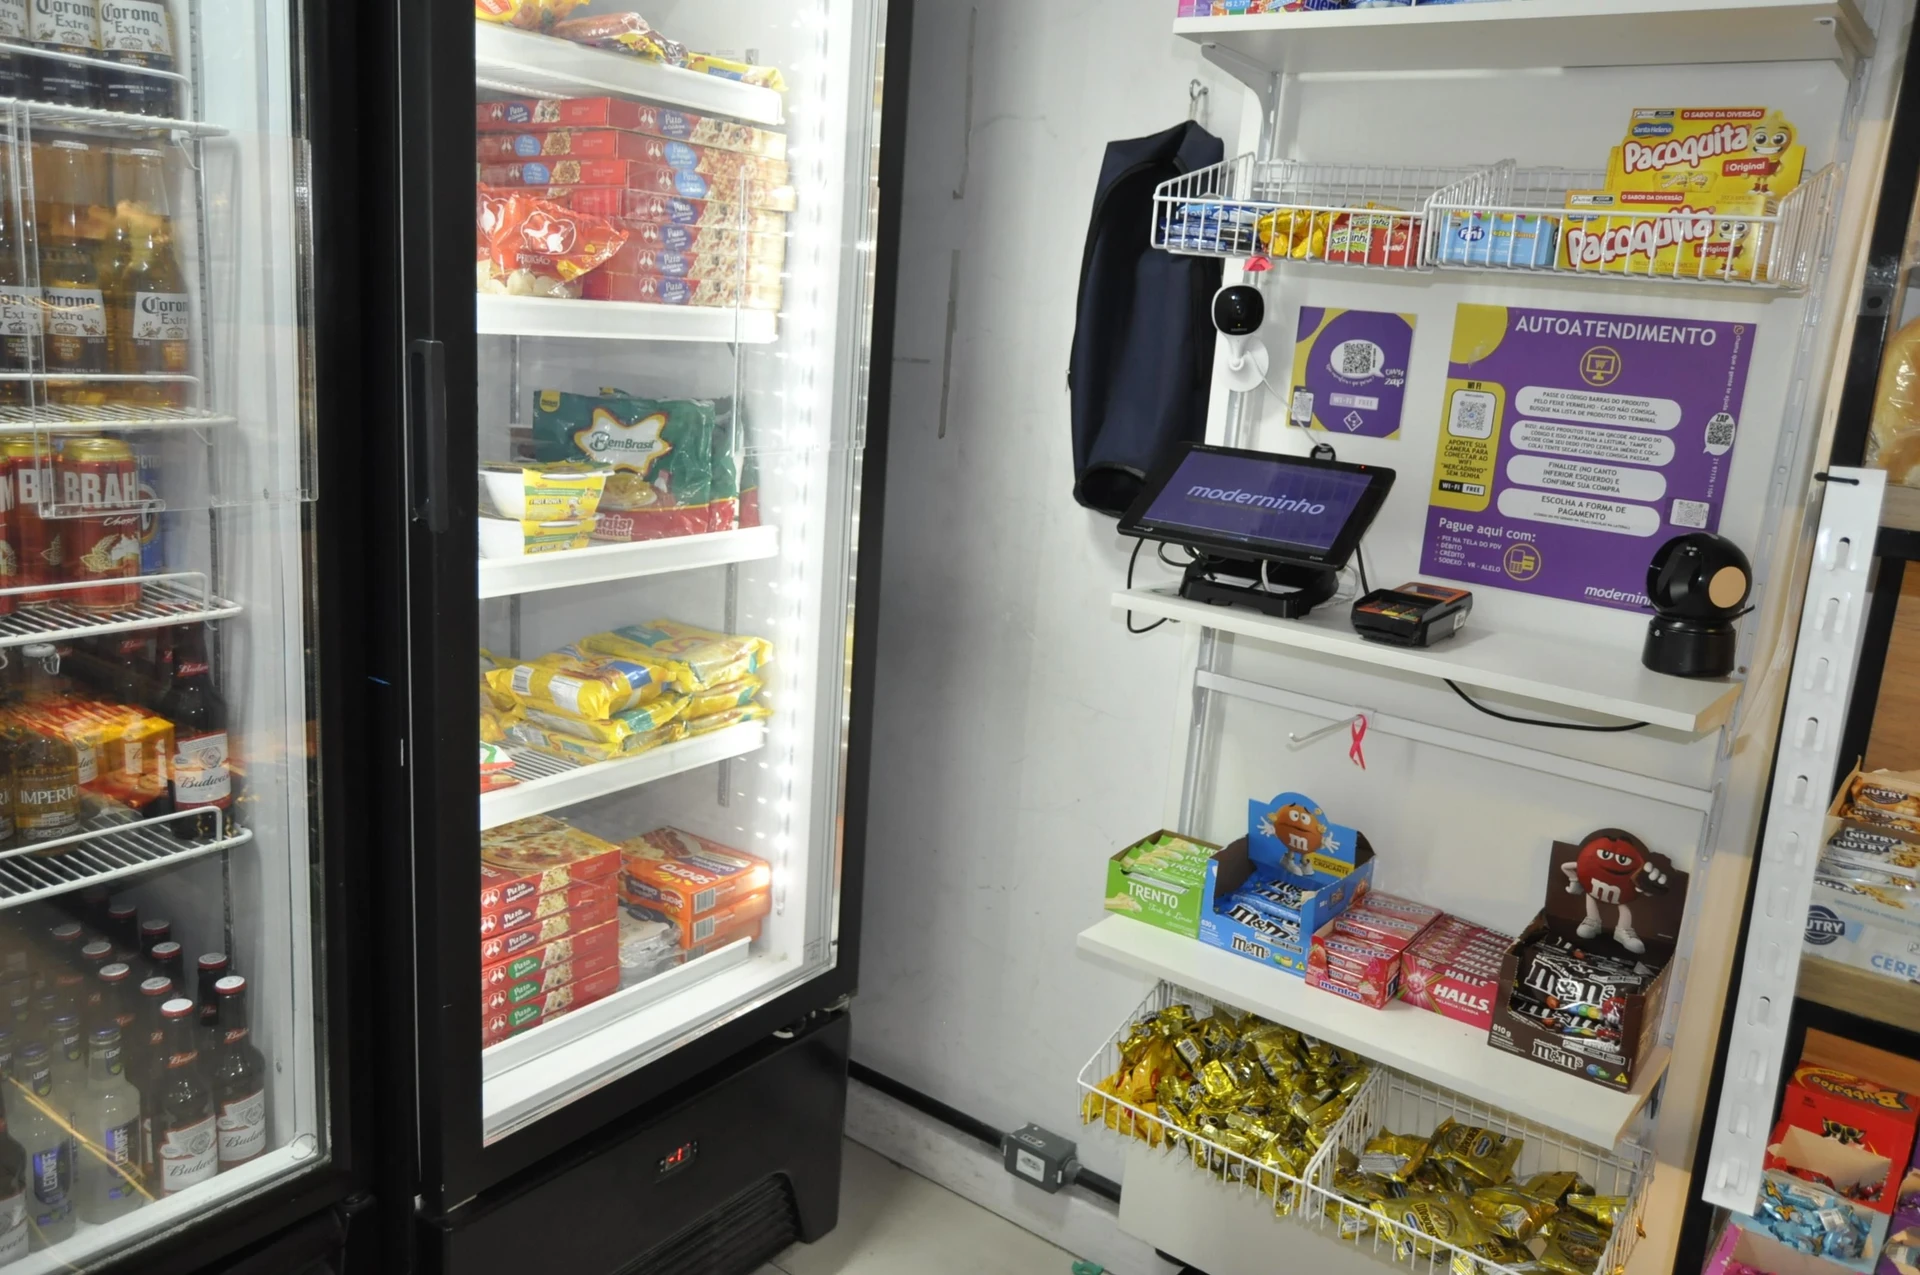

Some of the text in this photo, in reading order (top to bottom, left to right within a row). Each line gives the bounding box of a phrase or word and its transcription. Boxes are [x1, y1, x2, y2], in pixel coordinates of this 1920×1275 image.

[101, 2, 162, 26] Corona
[56, 14, 89, 31] Extra
[115, 22, 150, 36] Extra
[1715, 110, 1725, 118] DA
[1727, 109, 1762, 117] DIVERSÃO
[1624, 123, 1749, 174] Paçoquita
[1729, 162, 1765, 172] Original
[1514, 314, 1717, 347] AUTOATENDIMENTO
[1467, 381, 1482, 390] WI FI
[1542, 390, 1559, 398] PASSE
[1565, 393, 1588, 401] CÓDIGO
[1588, 395, 1610, 403] BARRAS
[1620, 398, 1650, 407] PRODUTO
[1528, 404, 1551, 412] BUSQUE
[1586, 410, 1616, 419] PRODUTOS
[1628, 415, 1656, 424] TERMINAL
[1533, 397, 1548, 405] PELO
[1548, 399, 1564, 407] FEIXE
[1565, 400, 1595, 410] VERMELHO
[1599, 404, 1616, 412] CASO
[1630, 407, 1658, 416] CONSIGA,
[1715, 413, 1729, 422] ZAP
[1444, 444, 1489, 455] CAMERA PARA
[1448, 438, 1472, 447] APONTE
[1443, 450, 1478, 460] CONECTAR
[1440, 462, 1487, 474] "MERCADINHO"
[1459, 471, 1480, 479] SENHA
[1548, 461, 1617, 476] FINALIZE (NO CANTO
[1541, 477, 1620, 493] CONFIRME SUA COMPRA
[1542, 469, 1620, 486] INFERIOR ESQUERDO) E
[1441, 482, 1480, 493] WI-FI FREE
[1187, 485, 1325, 515] moderninho
[1540, 495, 1626, 514] ESCOLHA A FORMA DE
[1557, 506, 1606, 520] PAGAMENTO
[1438, 516, 1474, 535] Pague
[1476, 522, 1503, 539] aqui
[1505, 526, 1537, 545] com:
[1440, 541, 1462, 551] DÉBITO
[1441, 534, 1502, 550] PIX NA TELA DO PDV
[1439, 548, 1465, 559] CRÉDITO
[1438, 556, 1501, 573] SODEXO VR ALELO
[1584, 583, 1654, 607] modernin
[1862, 787, 1906, 800] NUTRY
[1849, 830, 1898, 844] NUTRY
[1836, 839, 1888, 852] NUTRY
[659, 864, 714, 884] Seara
[507, 883, 526, 897] Pizza
[1127, 881, 1179, 909] TRENTO
[661, 893, 683, 908] Seara
[504, 909, 523, 922] Pizza
[1336, 922, 1366, 937] mentos
[1806, 918, 1842, 935] UTRY
[509, 933, 527, 945] Pizza
[514, 959, 530, 971] Pizza
[514, 983, 530, 995] Pizza
[1320, 979, 1361, 1001] mentos
[1433, 984, 1489, 1011] HALLS
[1492, 1023, 1506, 1035] 810
[1810, 1075, 1902, 1109] Bubbaloo
